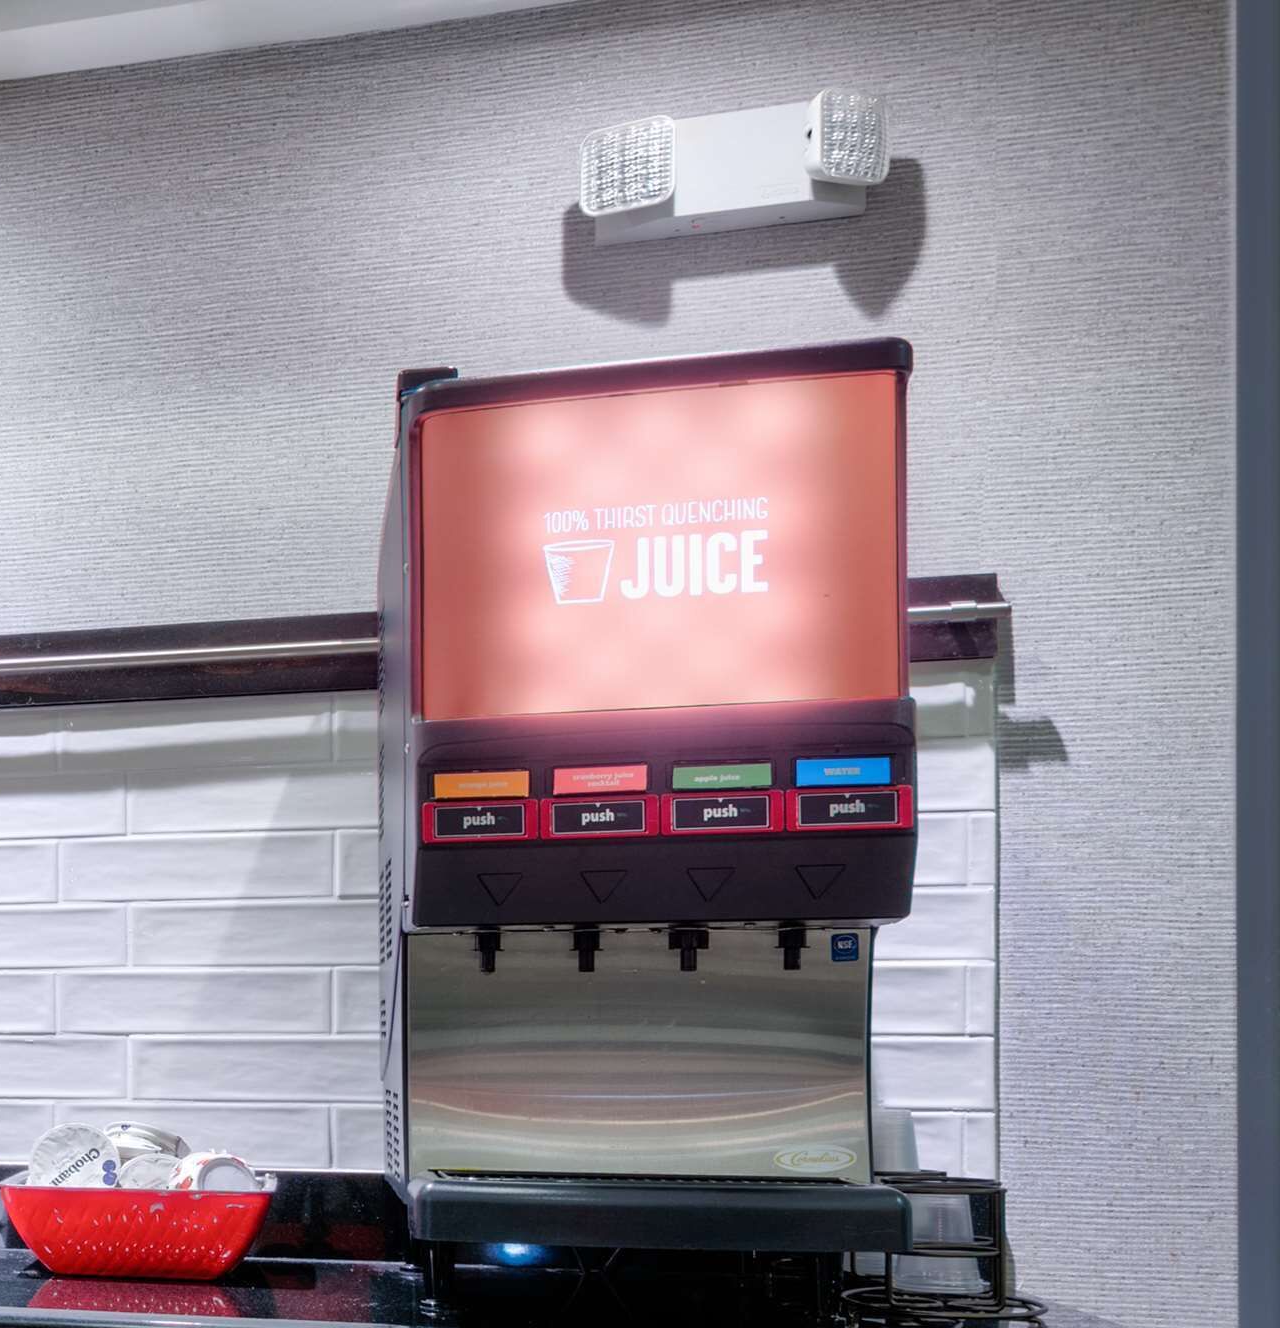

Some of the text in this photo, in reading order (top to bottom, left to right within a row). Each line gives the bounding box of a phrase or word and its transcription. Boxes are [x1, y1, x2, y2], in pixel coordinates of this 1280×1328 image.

[543, 497, 769, 533] 100% THIRST QUENCHING
[620, 529, 769, 599] JUICE
[572, 771, 634, 782] cranberry juice
[694, 773, 740, 783] apple juice
[823, 766, 861, 777] WATER
[587, 779, 620, 787] cocktail
[703, 804, 738, 821] push
[829, 799, 866, 817] push
[463, 812, 496, 829] push
[581, 809, 615, 826] push
[49, 1148, 101, 1186] Choban
